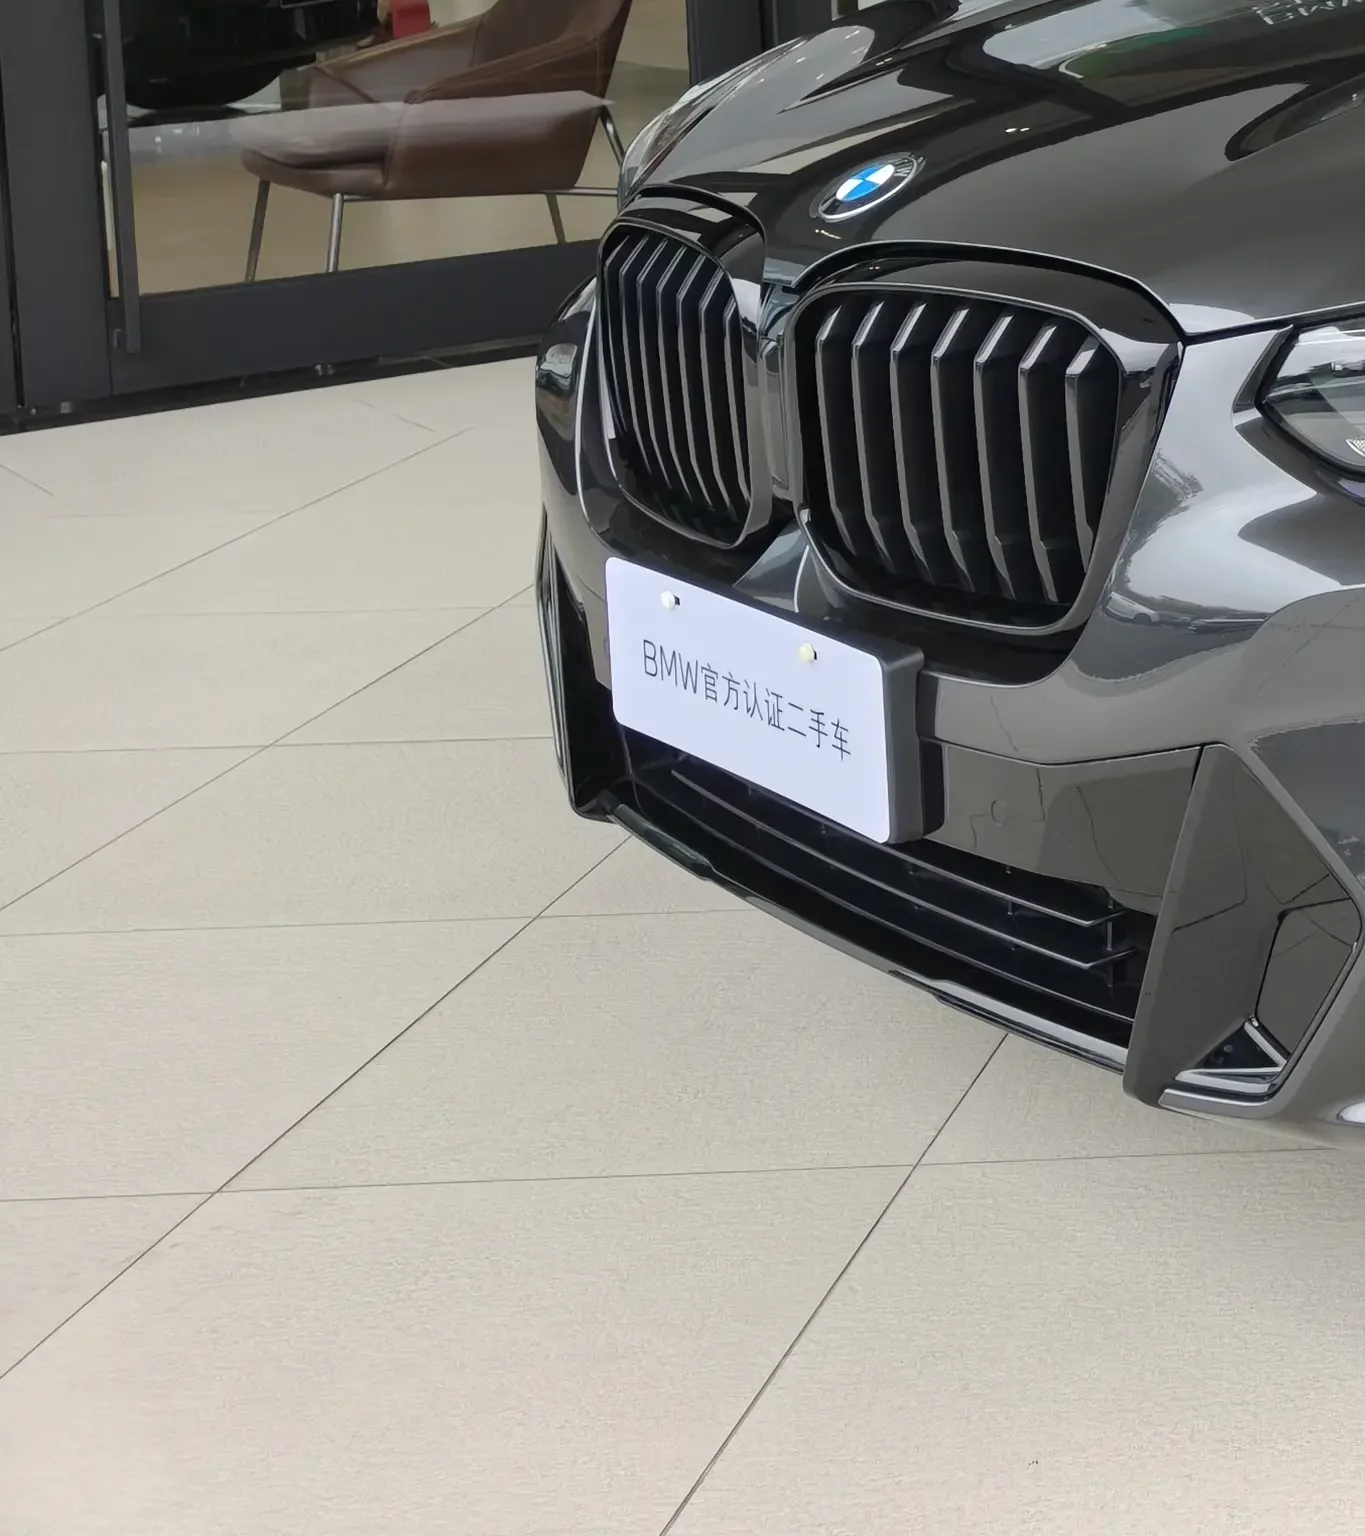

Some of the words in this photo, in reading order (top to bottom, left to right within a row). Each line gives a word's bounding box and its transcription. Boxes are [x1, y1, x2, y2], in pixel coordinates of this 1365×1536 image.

[642, 638, 852, 762] BMW官方认证二手车
